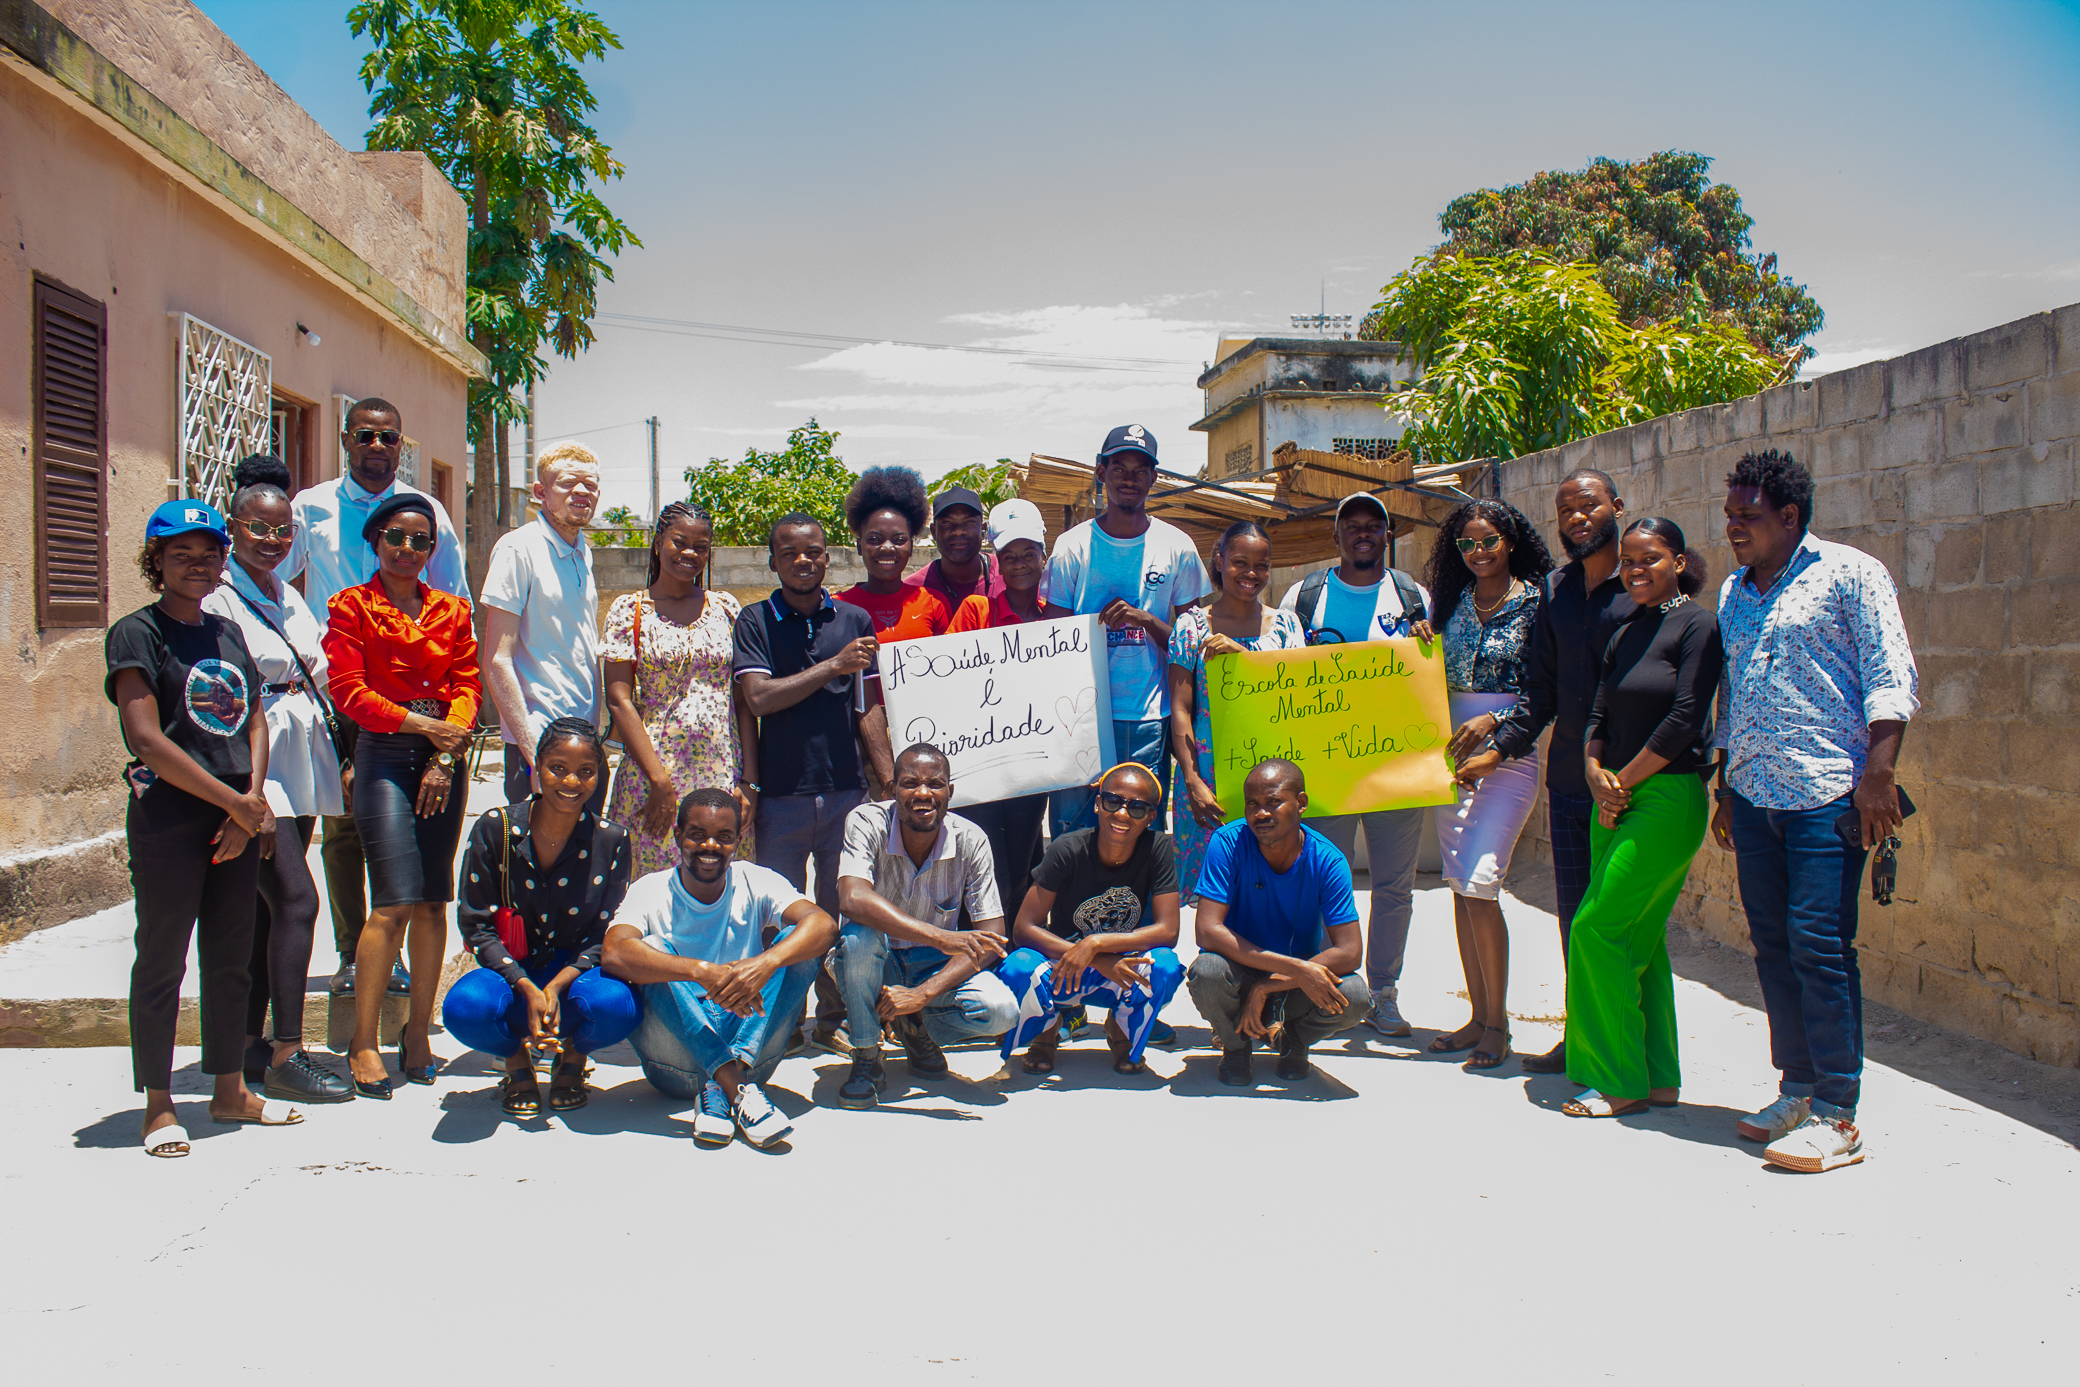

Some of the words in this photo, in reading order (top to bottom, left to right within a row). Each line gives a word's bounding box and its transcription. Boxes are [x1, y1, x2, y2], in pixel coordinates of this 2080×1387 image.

[1145, 571, 1165, 584] IGC
[888, 645, 906, 690] A
[906, 639, 995, 677] Saúde
[1000, 626, 1088, 664] Mental
[1221, 657, 1298, 701] Escola
[1305, 660, 1326, 688] de
[1328, 649, 1415, 683] Saúde
[1270, 688, 1351, 724] Mental
